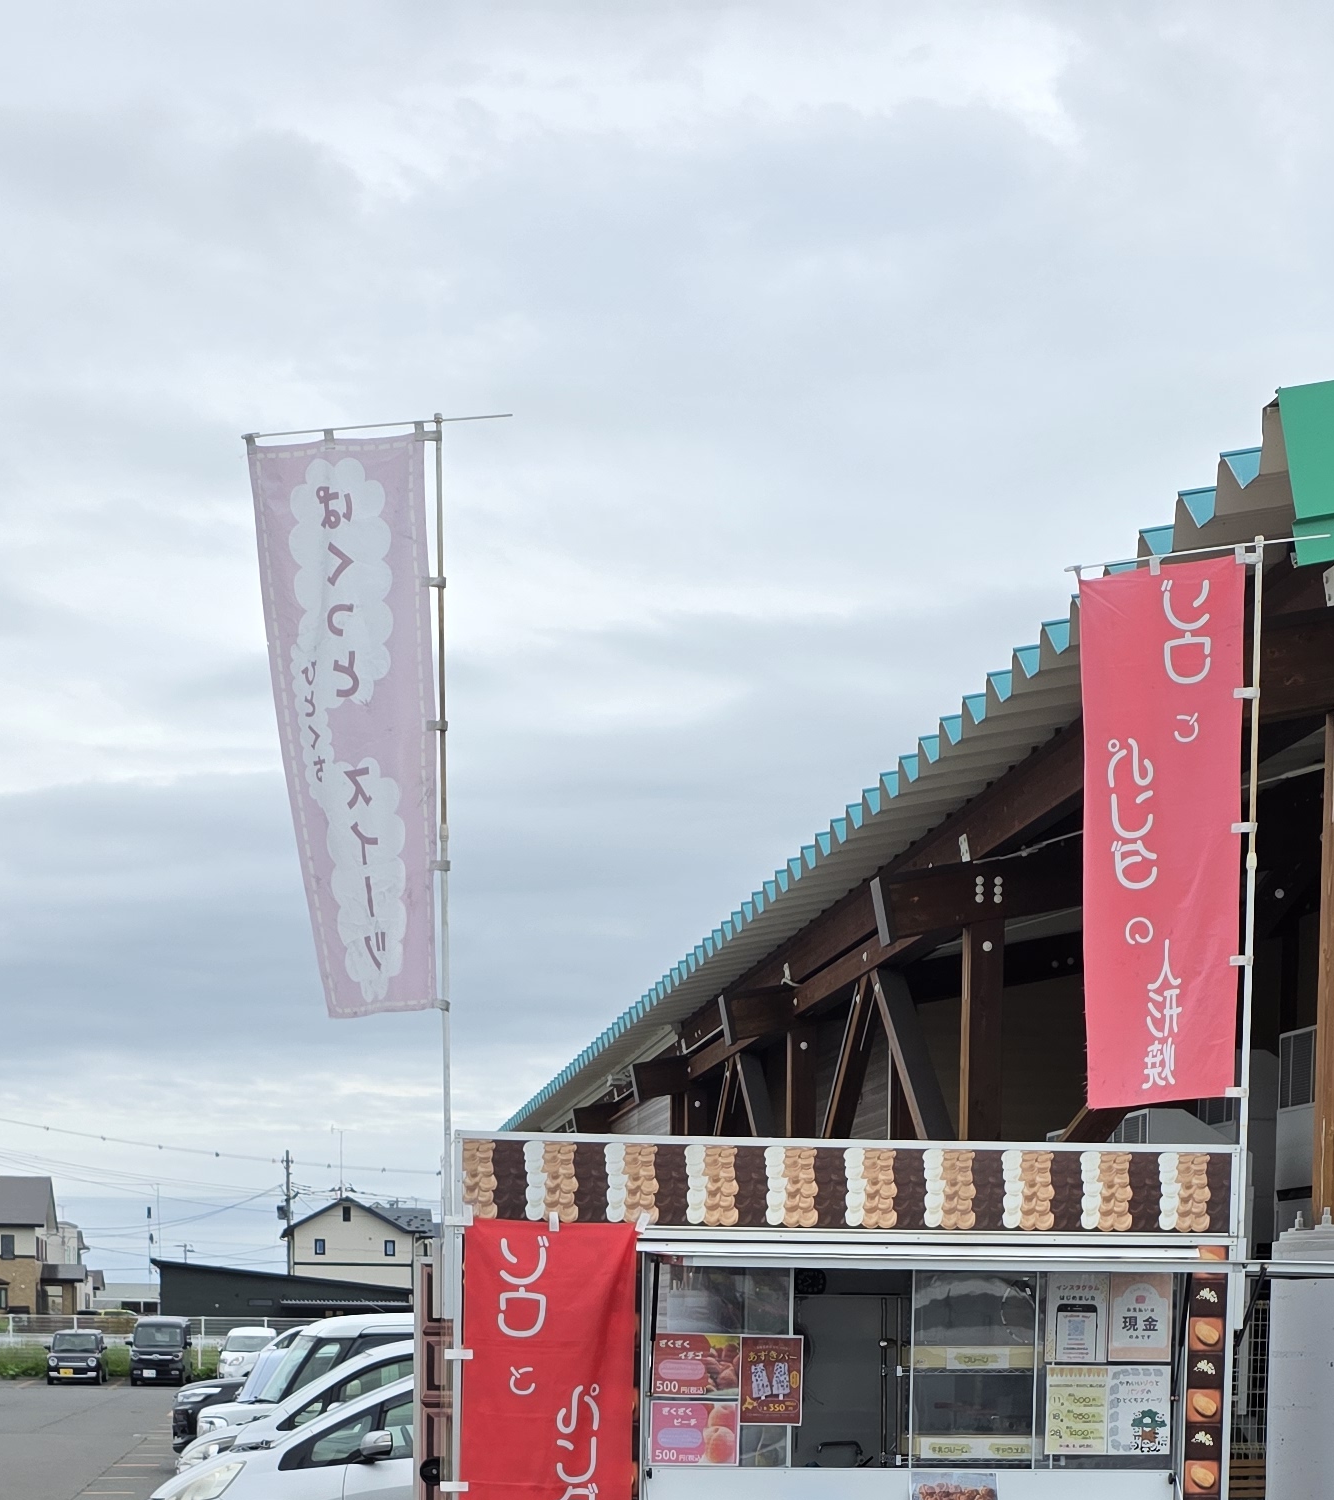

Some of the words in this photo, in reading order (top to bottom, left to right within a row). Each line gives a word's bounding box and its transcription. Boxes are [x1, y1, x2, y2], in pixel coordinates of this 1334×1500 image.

[1121, 1316, 1159, 1332] 現金
[678, 1351, 704, 1359] イチゴ
[747, 1350, 798, 1362] あずきバー
[655, 1381, 679, 1392] 500
[1073, 1396, 1091, 1404] 600
[768, 1403, 786, 1412] 350
[654, 1450, 677, 1461] 500
